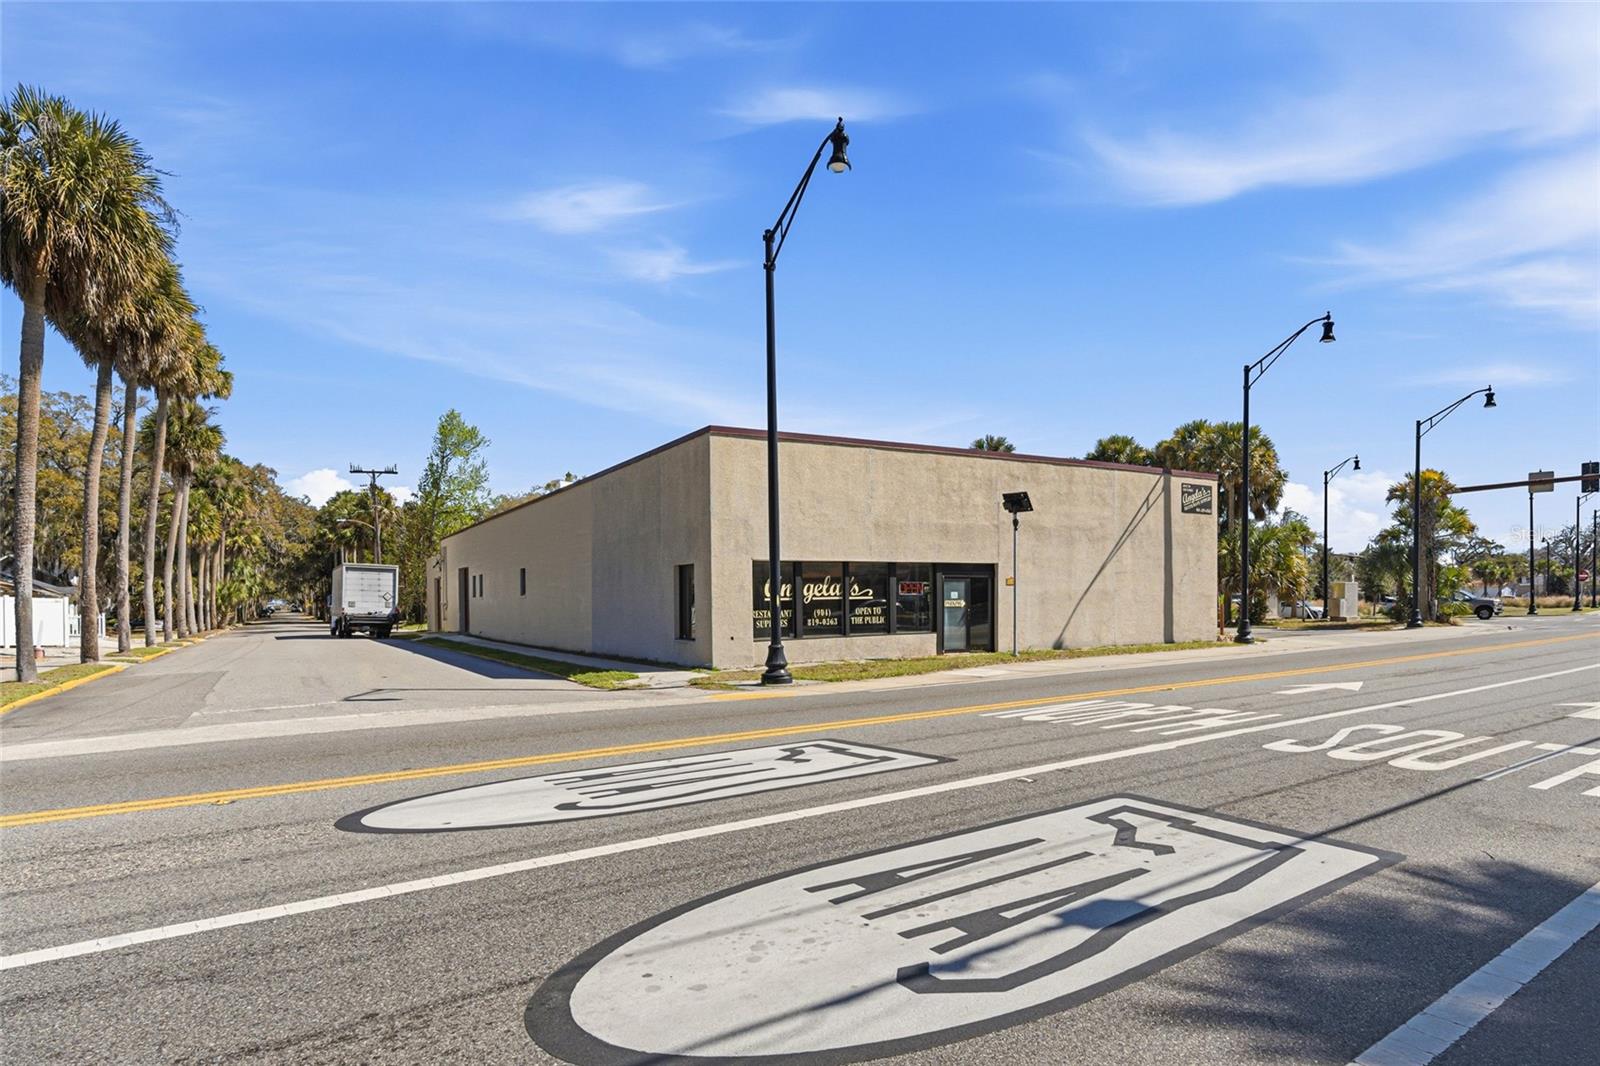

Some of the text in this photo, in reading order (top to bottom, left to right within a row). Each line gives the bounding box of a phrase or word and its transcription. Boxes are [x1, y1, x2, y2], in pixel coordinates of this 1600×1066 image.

[752, 609, 792, 618] RESTAANT
[855, 606, 881, 615] OPEN TO
[755, 619, 788, 628] SUPES
[851, 615, 885, 625] THE PUBLIC
[979, 699, 1282, 735] NORTH
[544, 758, 776, 799] A1A
[803, 837, 1151, 954] A1A
